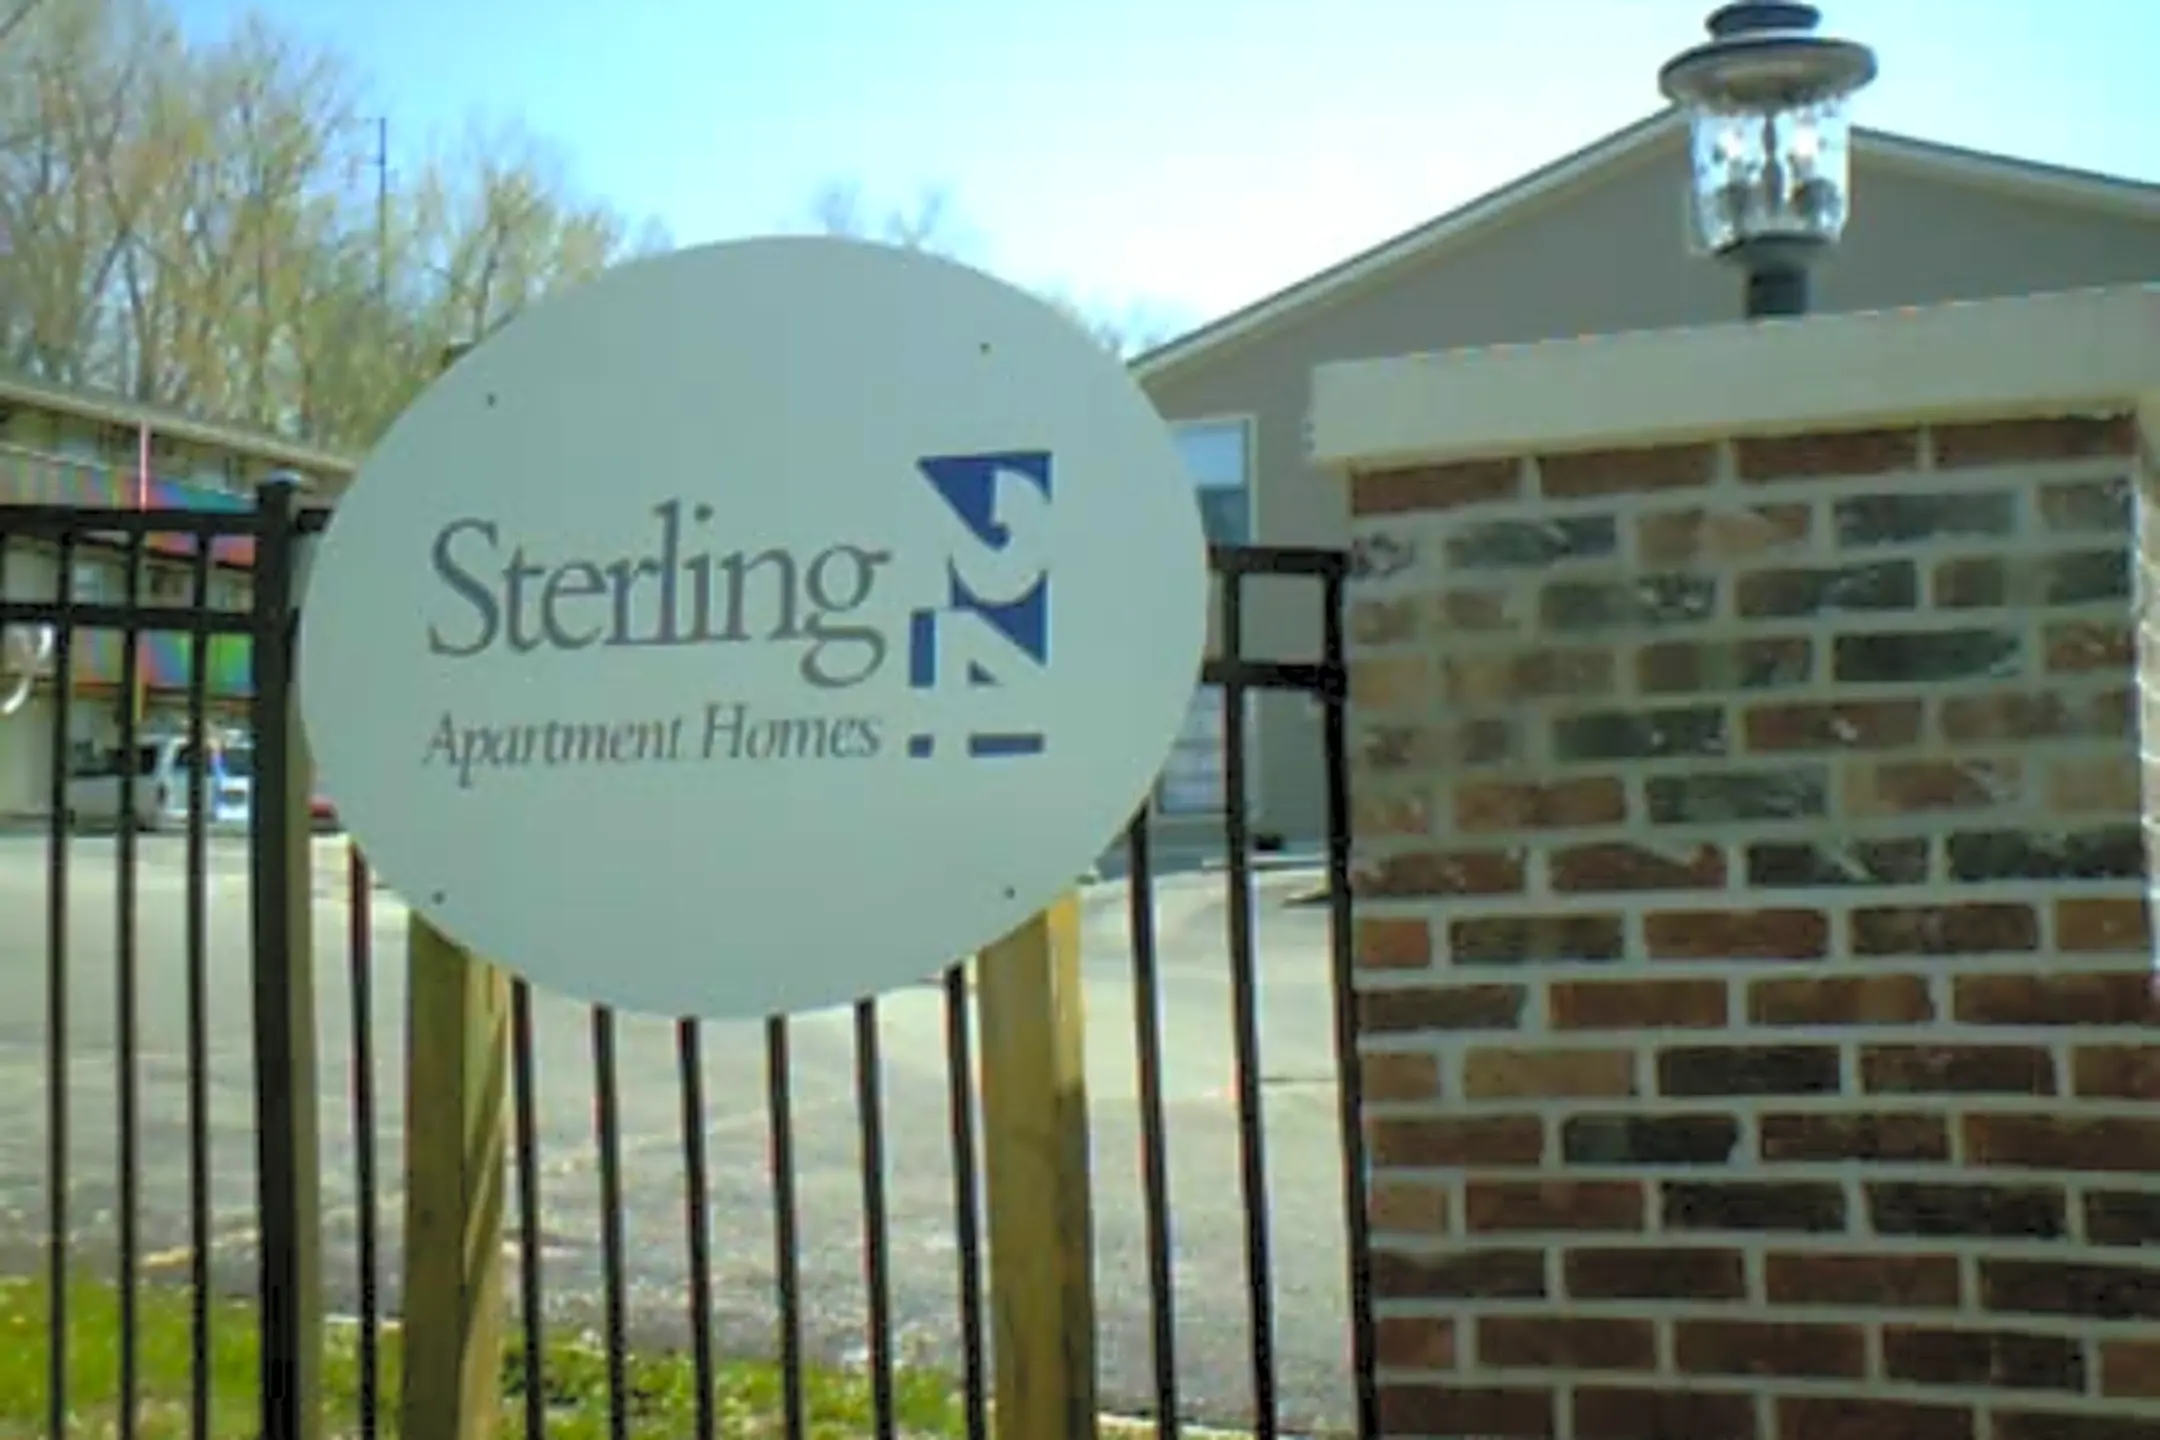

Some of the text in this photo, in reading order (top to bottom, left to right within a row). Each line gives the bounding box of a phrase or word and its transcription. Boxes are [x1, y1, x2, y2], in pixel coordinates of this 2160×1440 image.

[427, 498, 894, 689] Sterling
[421, 702, 883, 788] Apartment Homes
